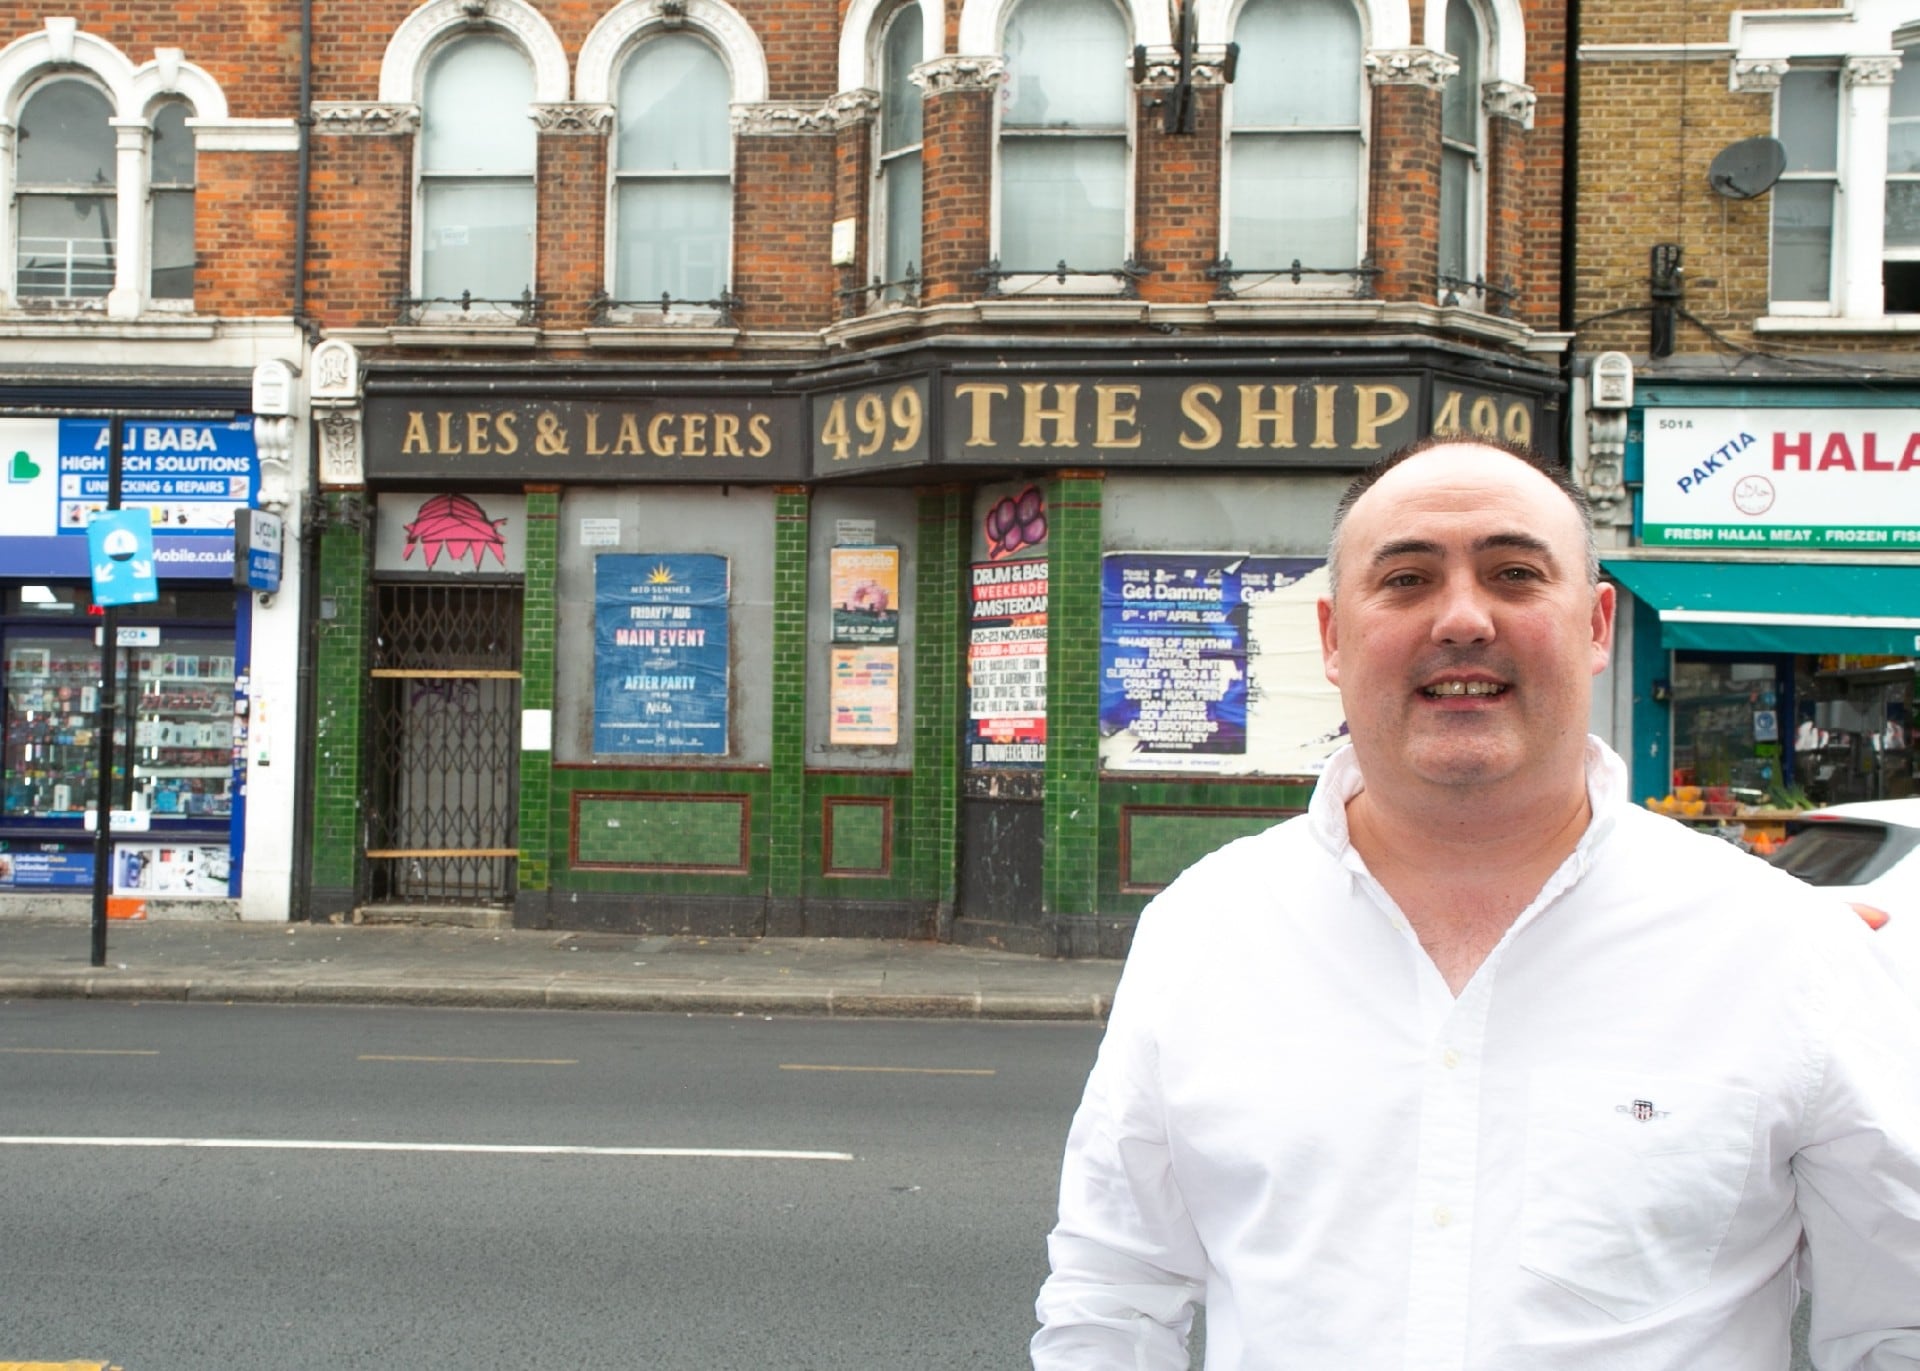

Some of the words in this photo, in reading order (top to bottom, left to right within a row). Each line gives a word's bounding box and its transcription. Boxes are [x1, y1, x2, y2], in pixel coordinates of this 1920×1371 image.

[821, 385, 923, 461] 499
[955, 383, 1143, 448] THE
[1178, 384, 1410, 450] SHIP
[1659, 420, 1693, 429] 501A
[143, 428, 217, 451] BABA
[402, 411, 519, 455] ALES
[536, 411, 570, 456] &
[585, 412, 772, 457] LAGERS
[61, 455, 106, 471] HIGH
[155, 456, 250, 472] SOLUTIONS
[1676, 431, 1757, 494] PAKTIA
[176, 480, 224, 494] REPAIRS
[1664, 528, 1713, 540] FRESH
[1718, 528, 1766, 541] HALAL
[1769, 529, 1812, 541] MEAT
[1825, 530, 1887, 542] FROZEN
[973, 566, 1011, 585] DRUM
[1012, 565, 1023, 581] &
[1123, 583, 1152, 599] Get
[630, 606, 660, 619] FRIDAY
[673, 606, 691, 619] AUG
[1167, 611, 1200, 622] APRIL
[616, 630, 655, 646] MAIN
[659, 630, 705, 647] EVENT
[1118, 637, 1164, 649] SHADES
[1166, 638, 1183, 649] OF
[1183, 638, 1232, 650] RHYTHM
[1114, 658, 1145, 669] BILLY
[624, 676, 659, 690] AFTER
[660, 676, 696, 690] PARTY
